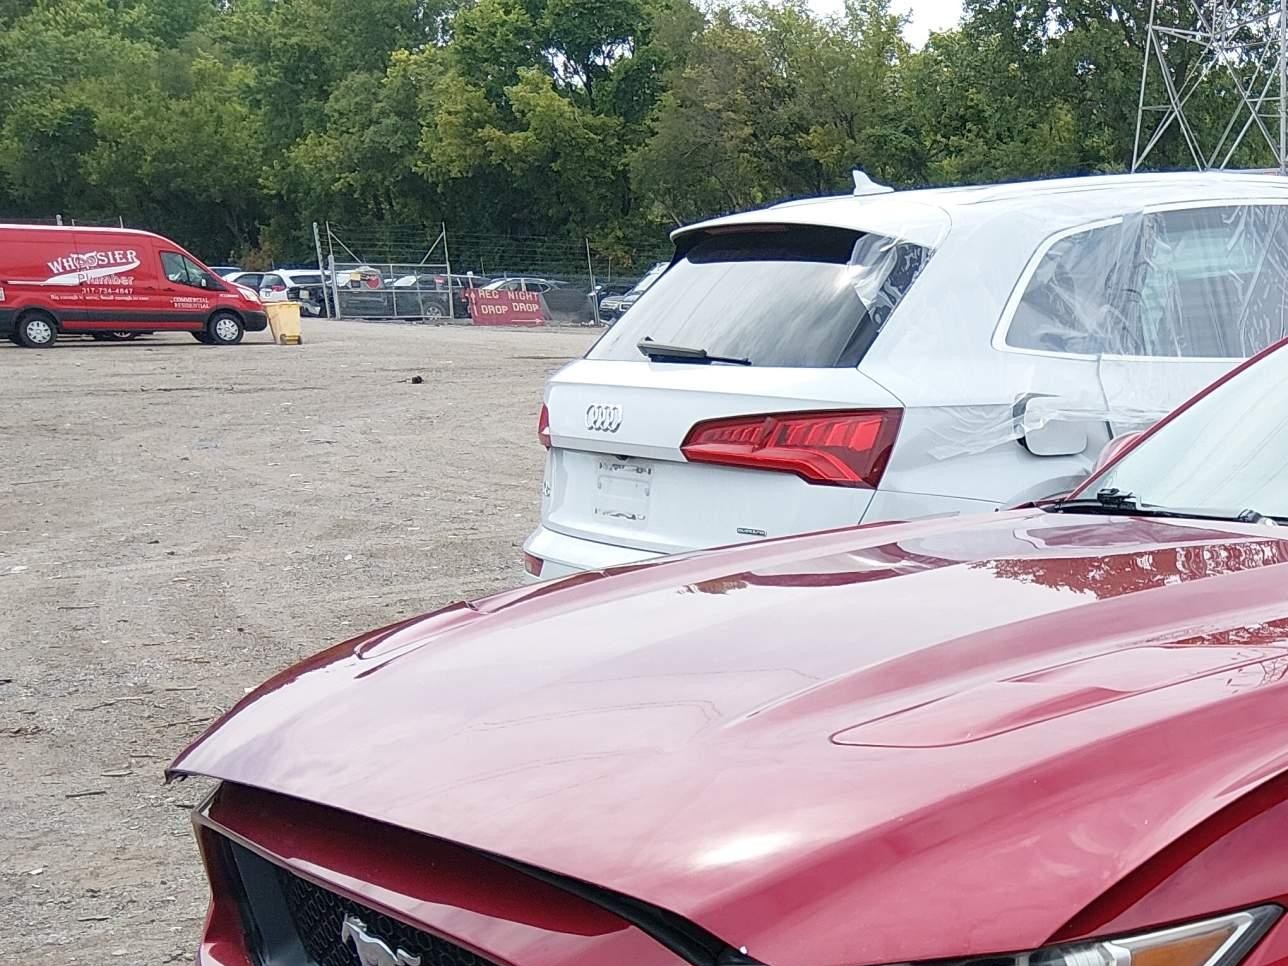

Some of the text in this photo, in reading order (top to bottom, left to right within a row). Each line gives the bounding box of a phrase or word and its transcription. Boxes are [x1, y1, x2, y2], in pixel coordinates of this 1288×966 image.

[507, 291, 539, 301] NIGHT
[481, 304, 509, 314] DROP
[512, 302, 539, 313] DROP
